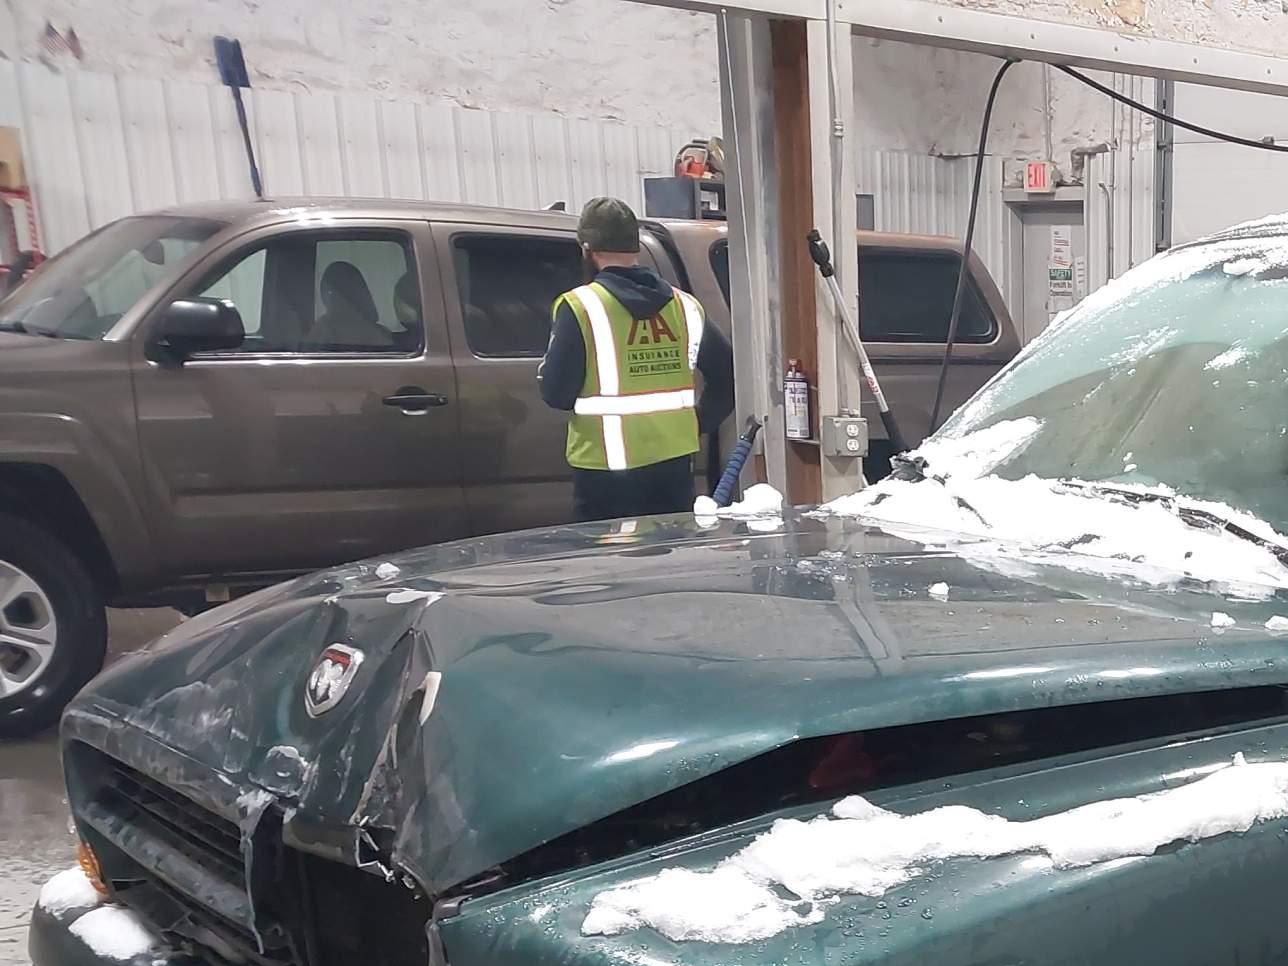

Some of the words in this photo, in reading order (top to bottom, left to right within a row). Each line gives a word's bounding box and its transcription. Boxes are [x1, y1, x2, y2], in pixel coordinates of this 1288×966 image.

[1028, 163, 1046, 187] EXIT
[627, 350, 680, 361] INSURANCE
[629, 365, 649, 374] AUTO
[650, 362, 681, 372] AUCTIONS
